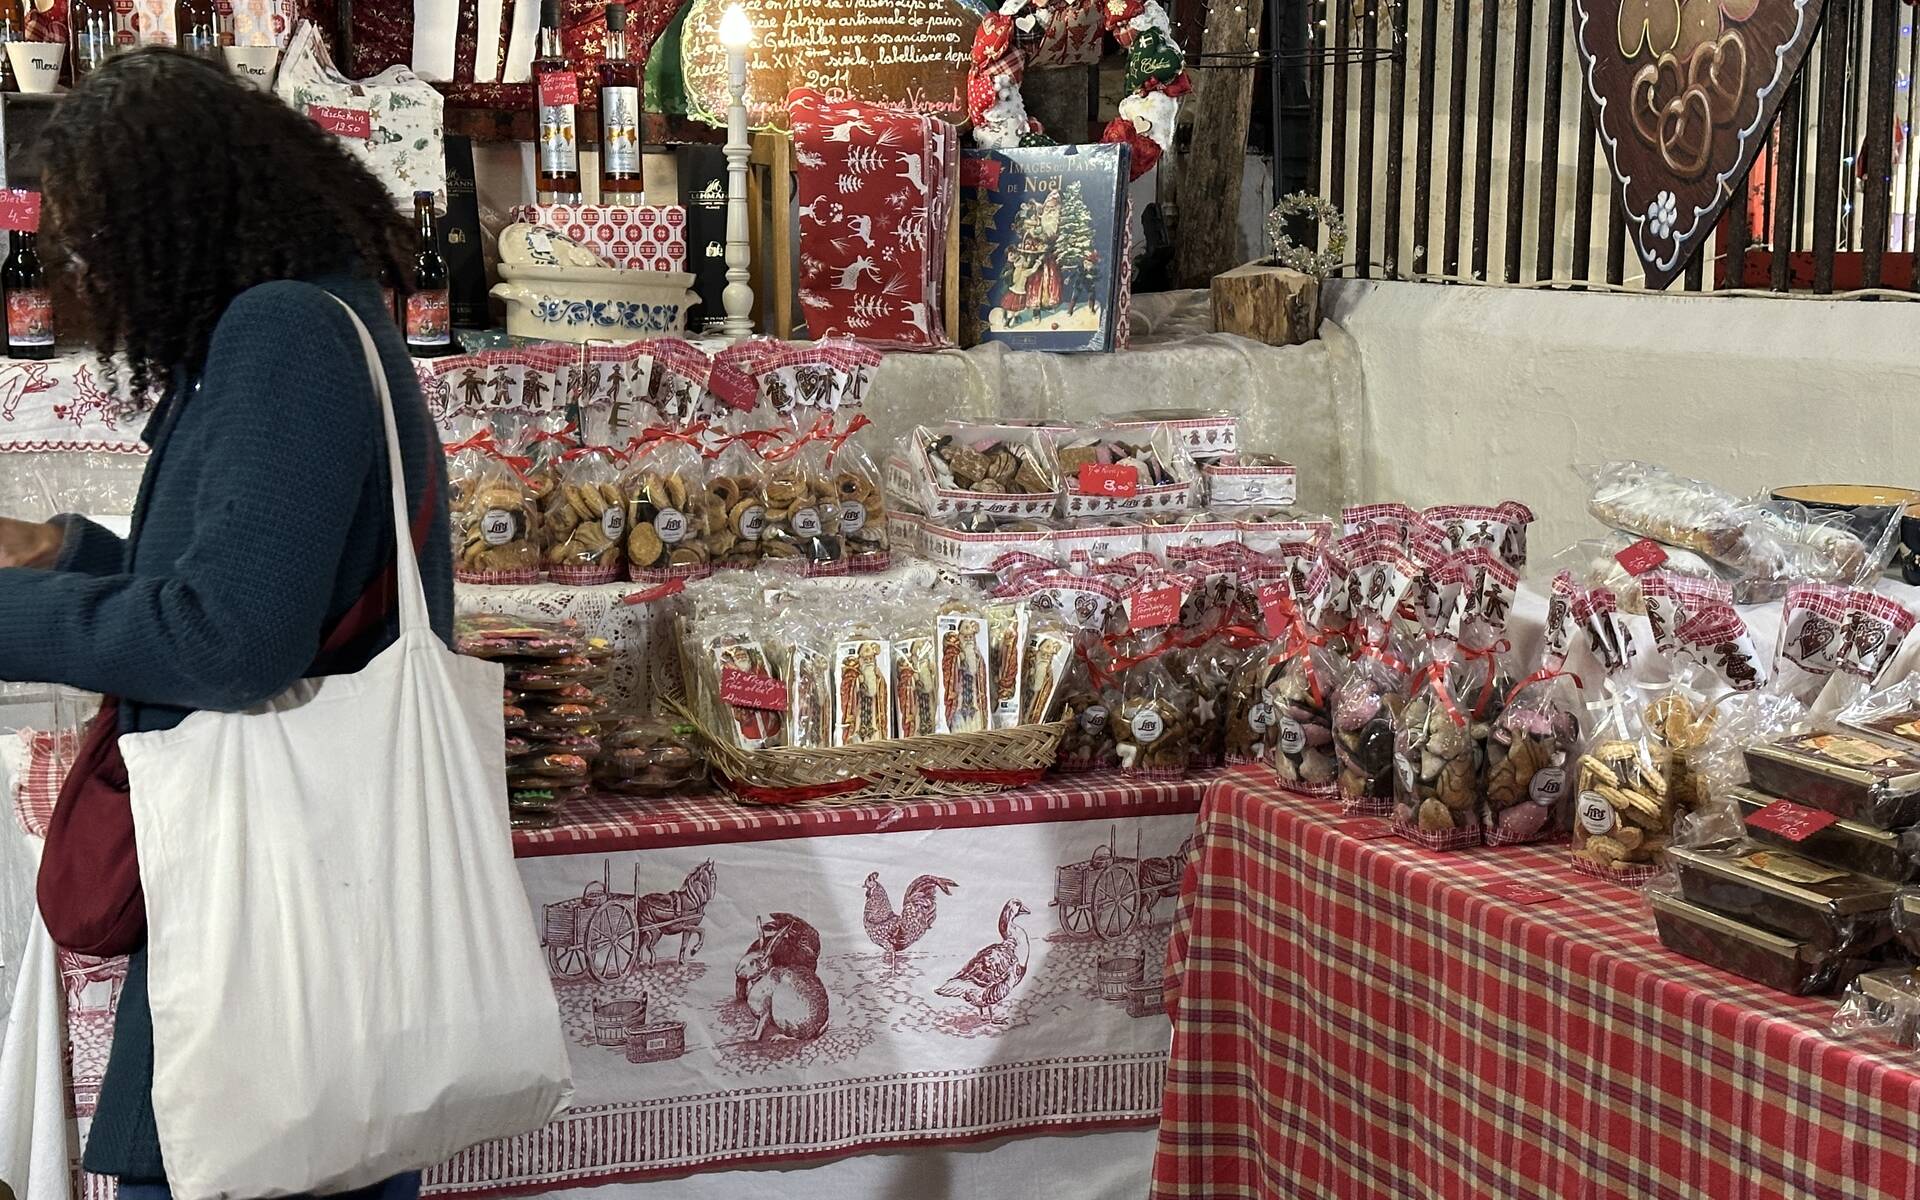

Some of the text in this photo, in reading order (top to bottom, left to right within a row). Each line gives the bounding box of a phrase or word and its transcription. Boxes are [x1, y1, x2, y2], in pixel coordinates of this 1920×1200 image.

[838, 8, 906, 27] artisanale
[907, 12, 924, 27] de
[806, 69, 850, 89] 2011
[1023, 174, 1063, 193] Noël
